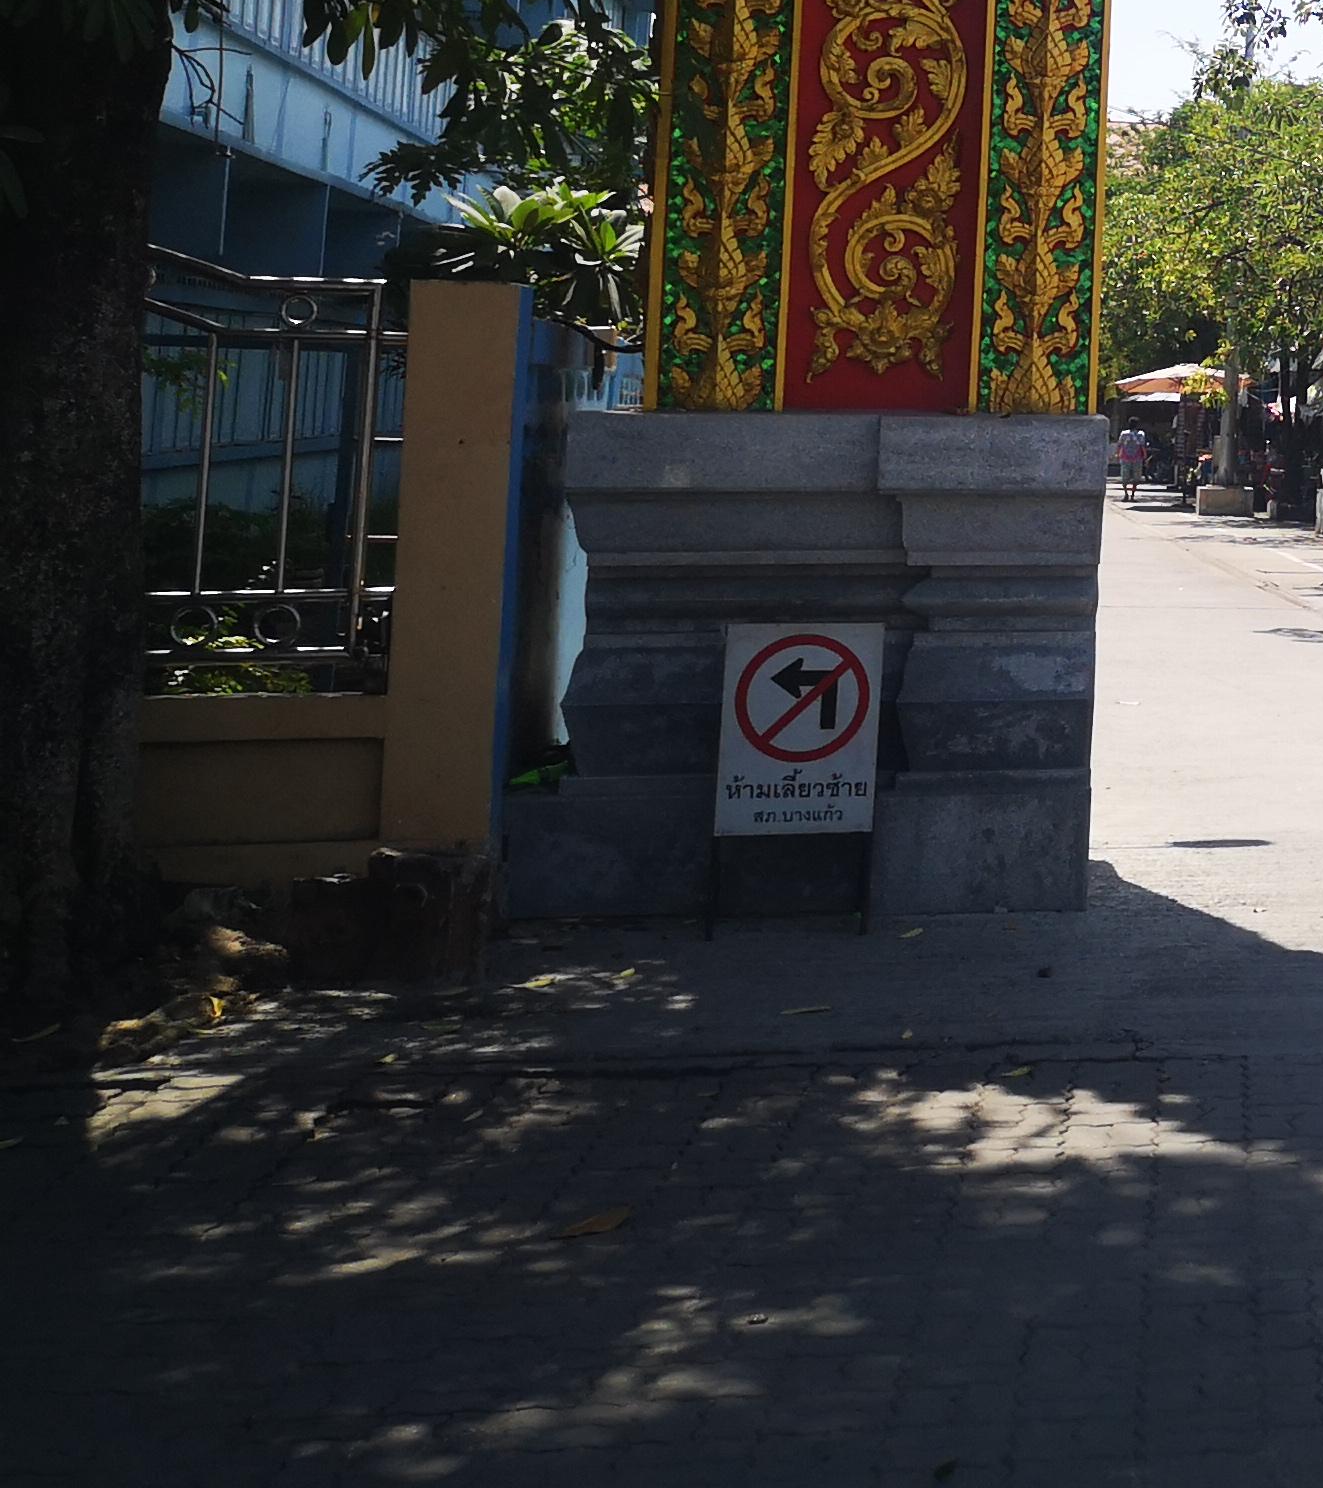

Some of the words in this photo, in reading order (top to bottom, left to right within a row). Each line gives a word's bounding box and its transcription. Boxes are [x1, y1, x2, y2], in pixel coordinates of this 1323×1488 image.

[725, 768, 868, 800] ห้ามเลี้ยวซ้าย
